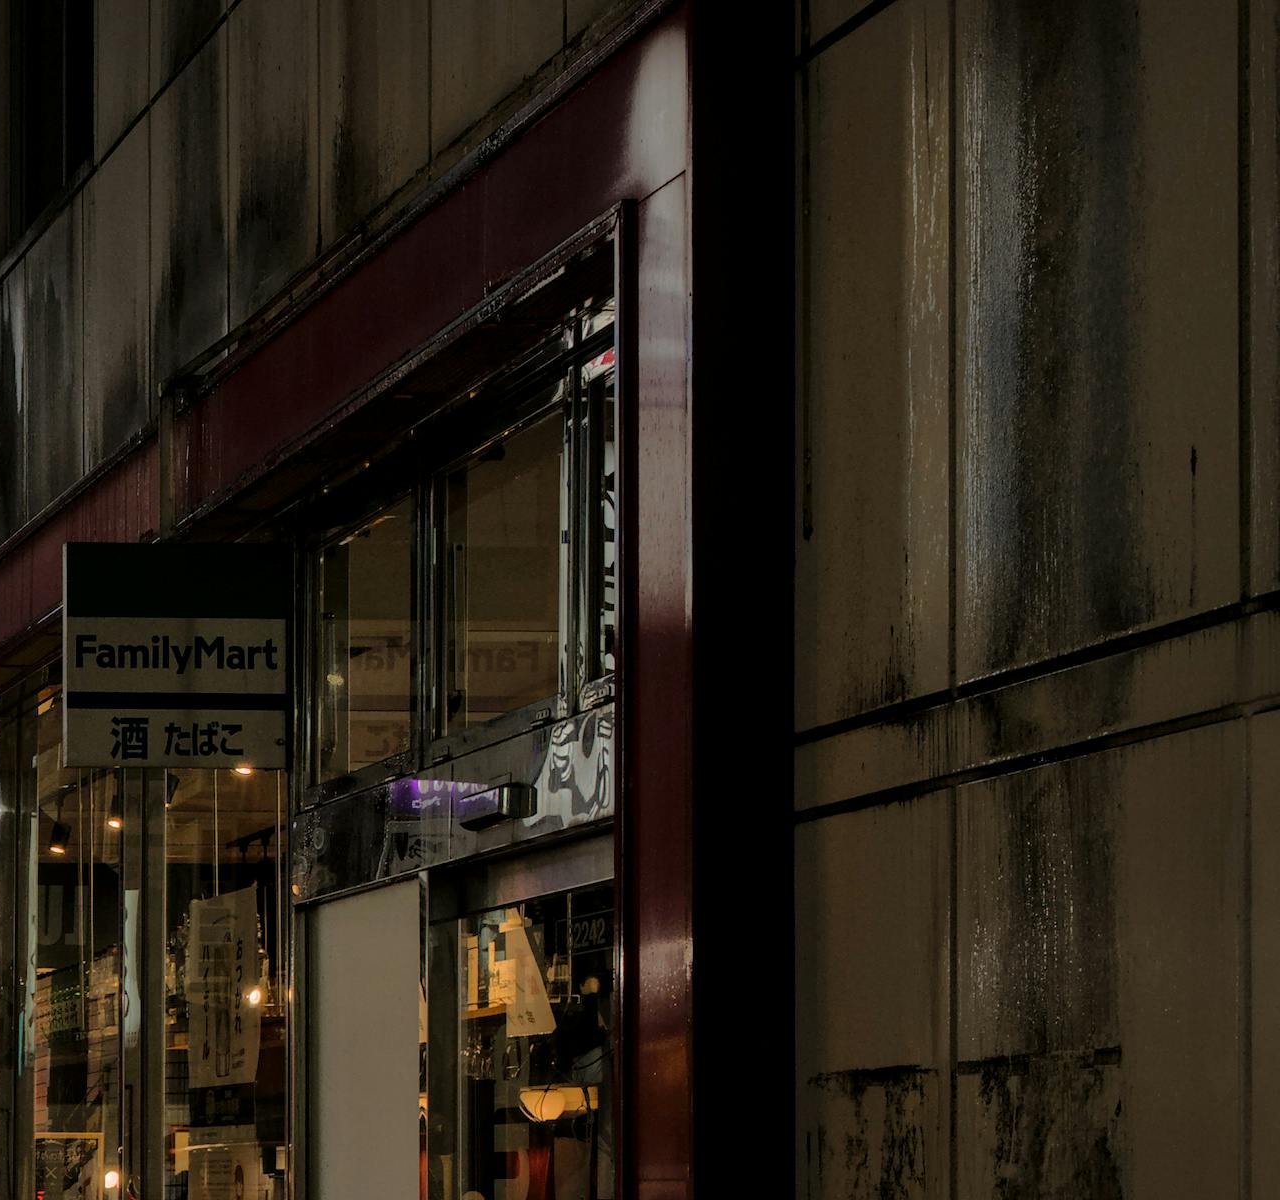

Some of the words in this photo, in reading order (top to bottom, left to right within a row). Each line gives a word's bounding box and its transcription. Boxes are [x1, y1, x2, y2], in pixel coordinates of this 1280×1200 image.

[75, 635, 278, 674] FamilyMart
[111, 717, 149, 759] 酒
[165, 721, 244, 756] たばこ
